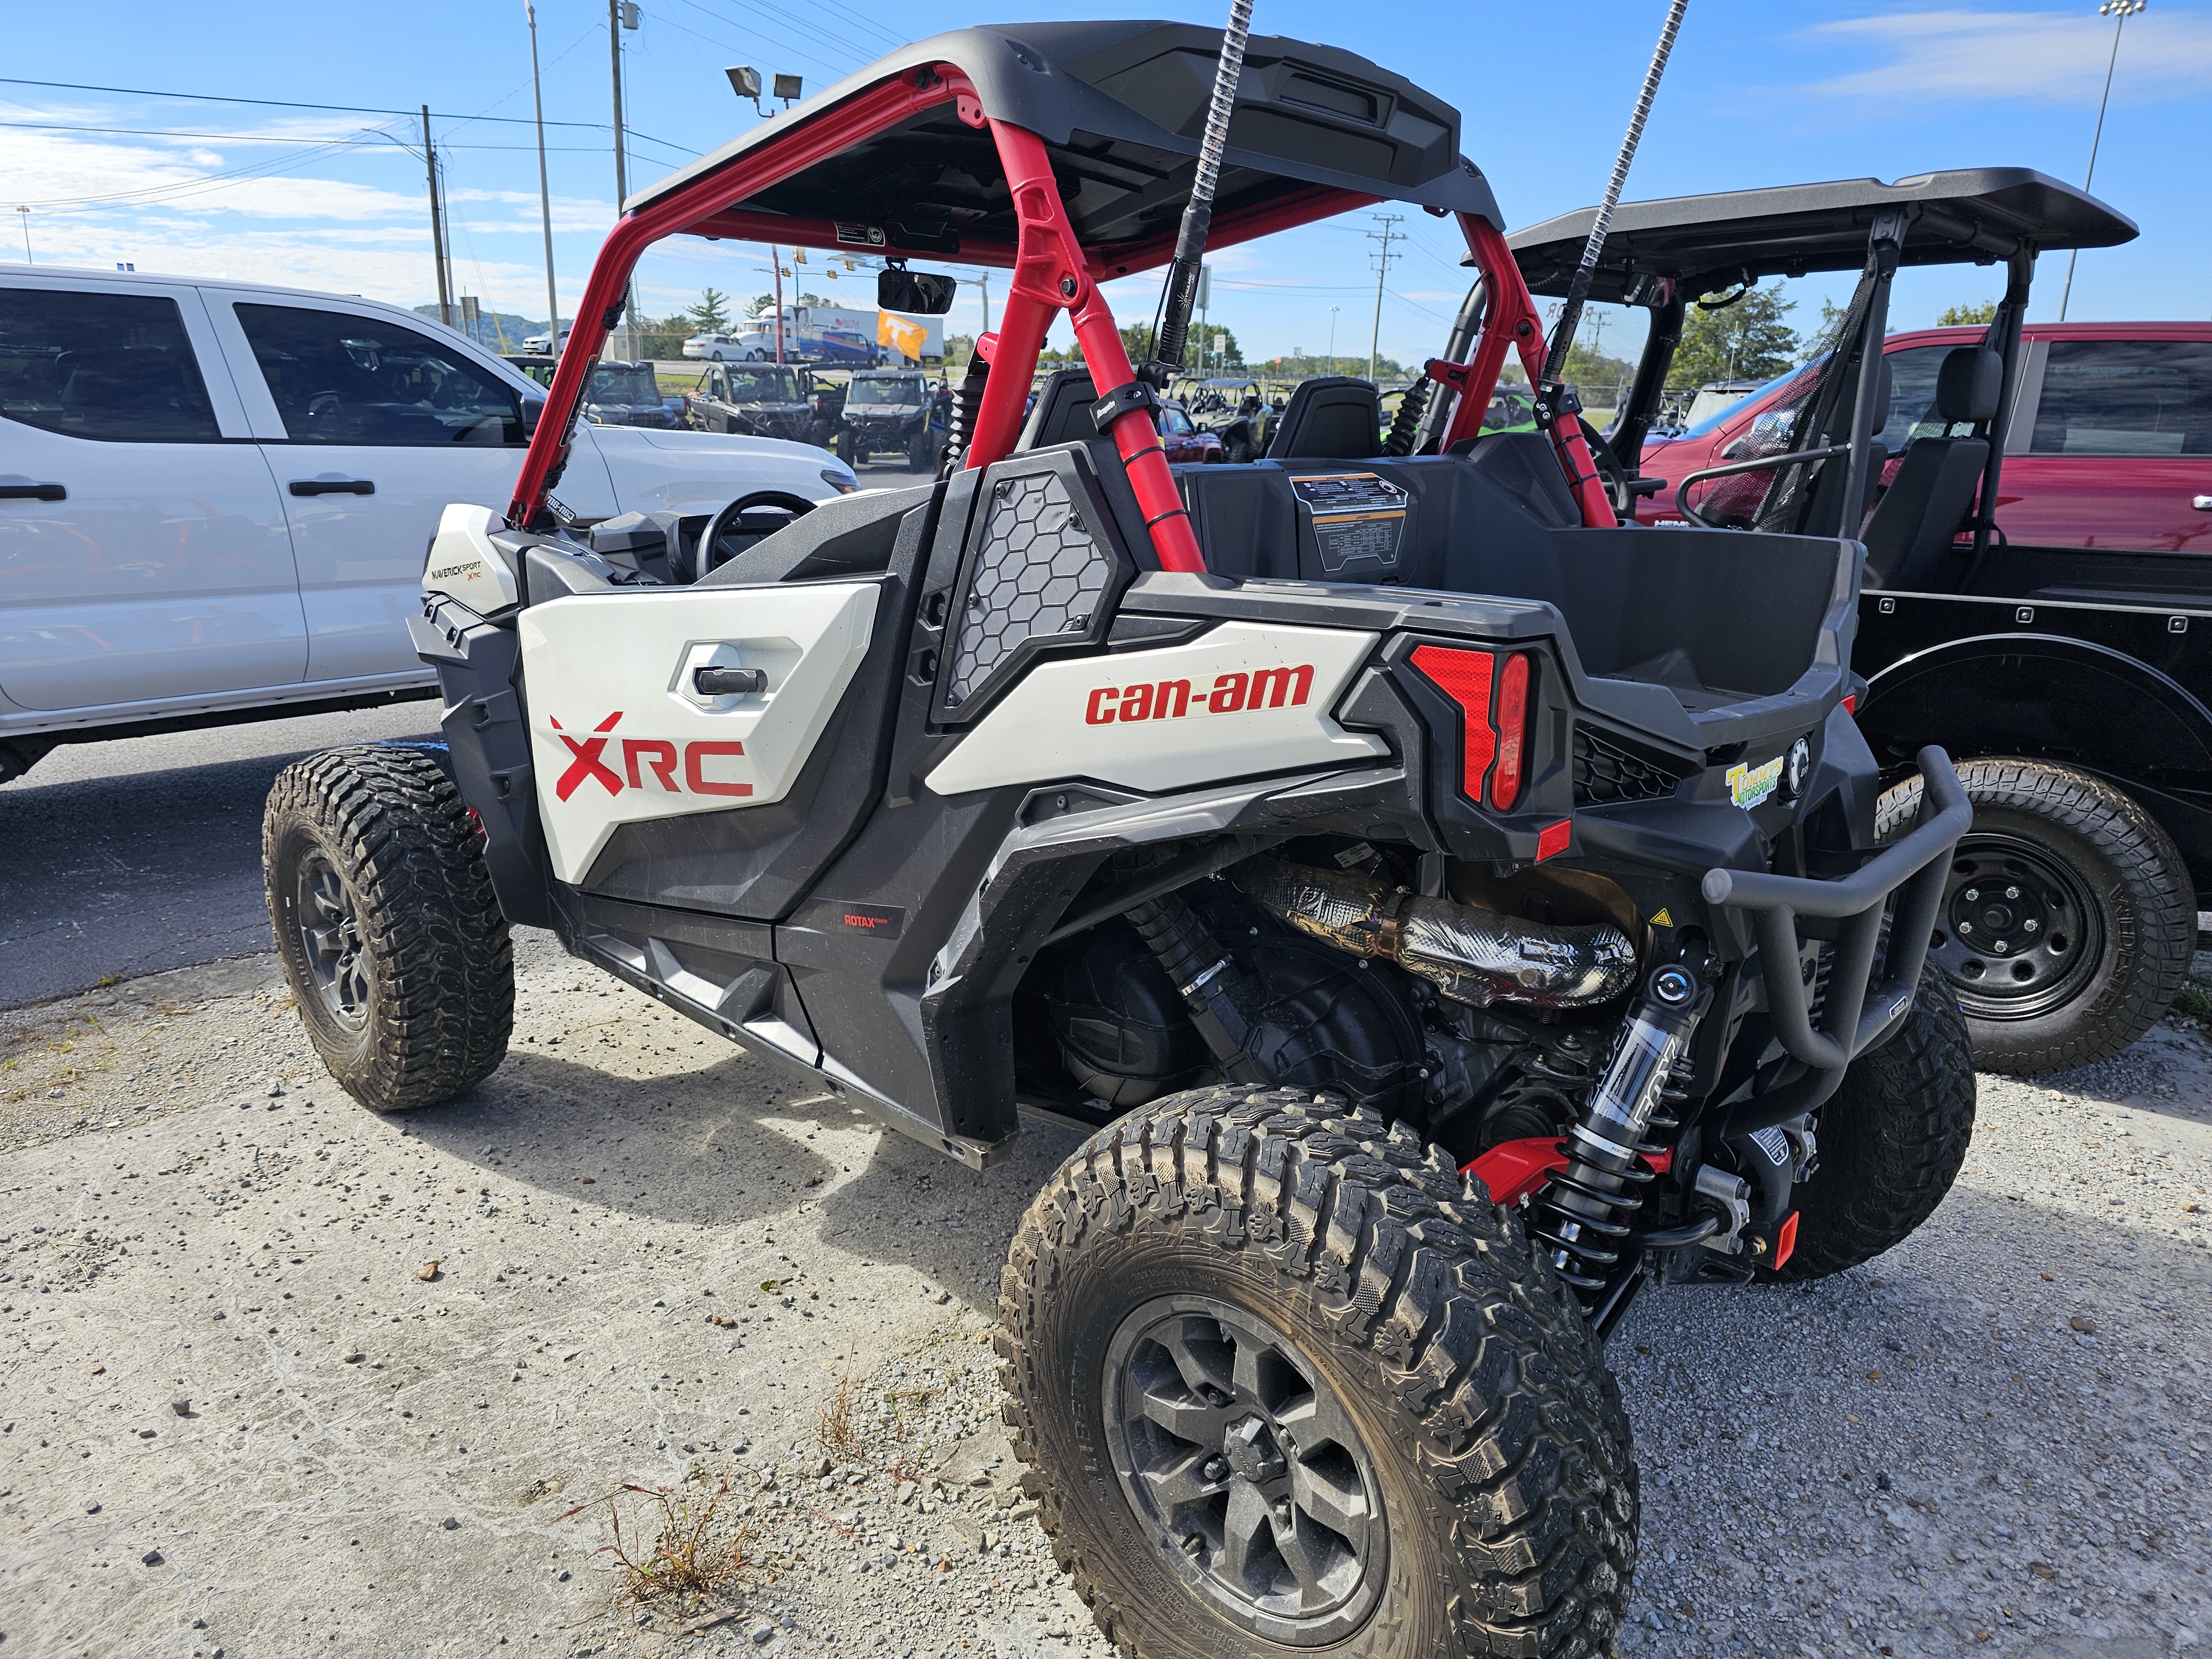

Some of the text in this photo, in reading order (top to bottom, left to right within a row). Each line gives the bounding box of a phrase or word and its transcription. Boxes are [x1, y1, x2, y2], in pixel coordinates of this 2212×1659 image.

[1183, 272, 1193, 303] DYNAMIC
[885, 317, 914, 349] T
[432, 561, 481, 580] MAVERICK SPORT
[467, 572, 481, 581] XRC
[1086, 664, 1315, 725] can-am
[549, 711, 753, 803] XRC
[1727, 761, 1782, 804] TOMMY'S
[844, 914, 875, 928] ROTAX
